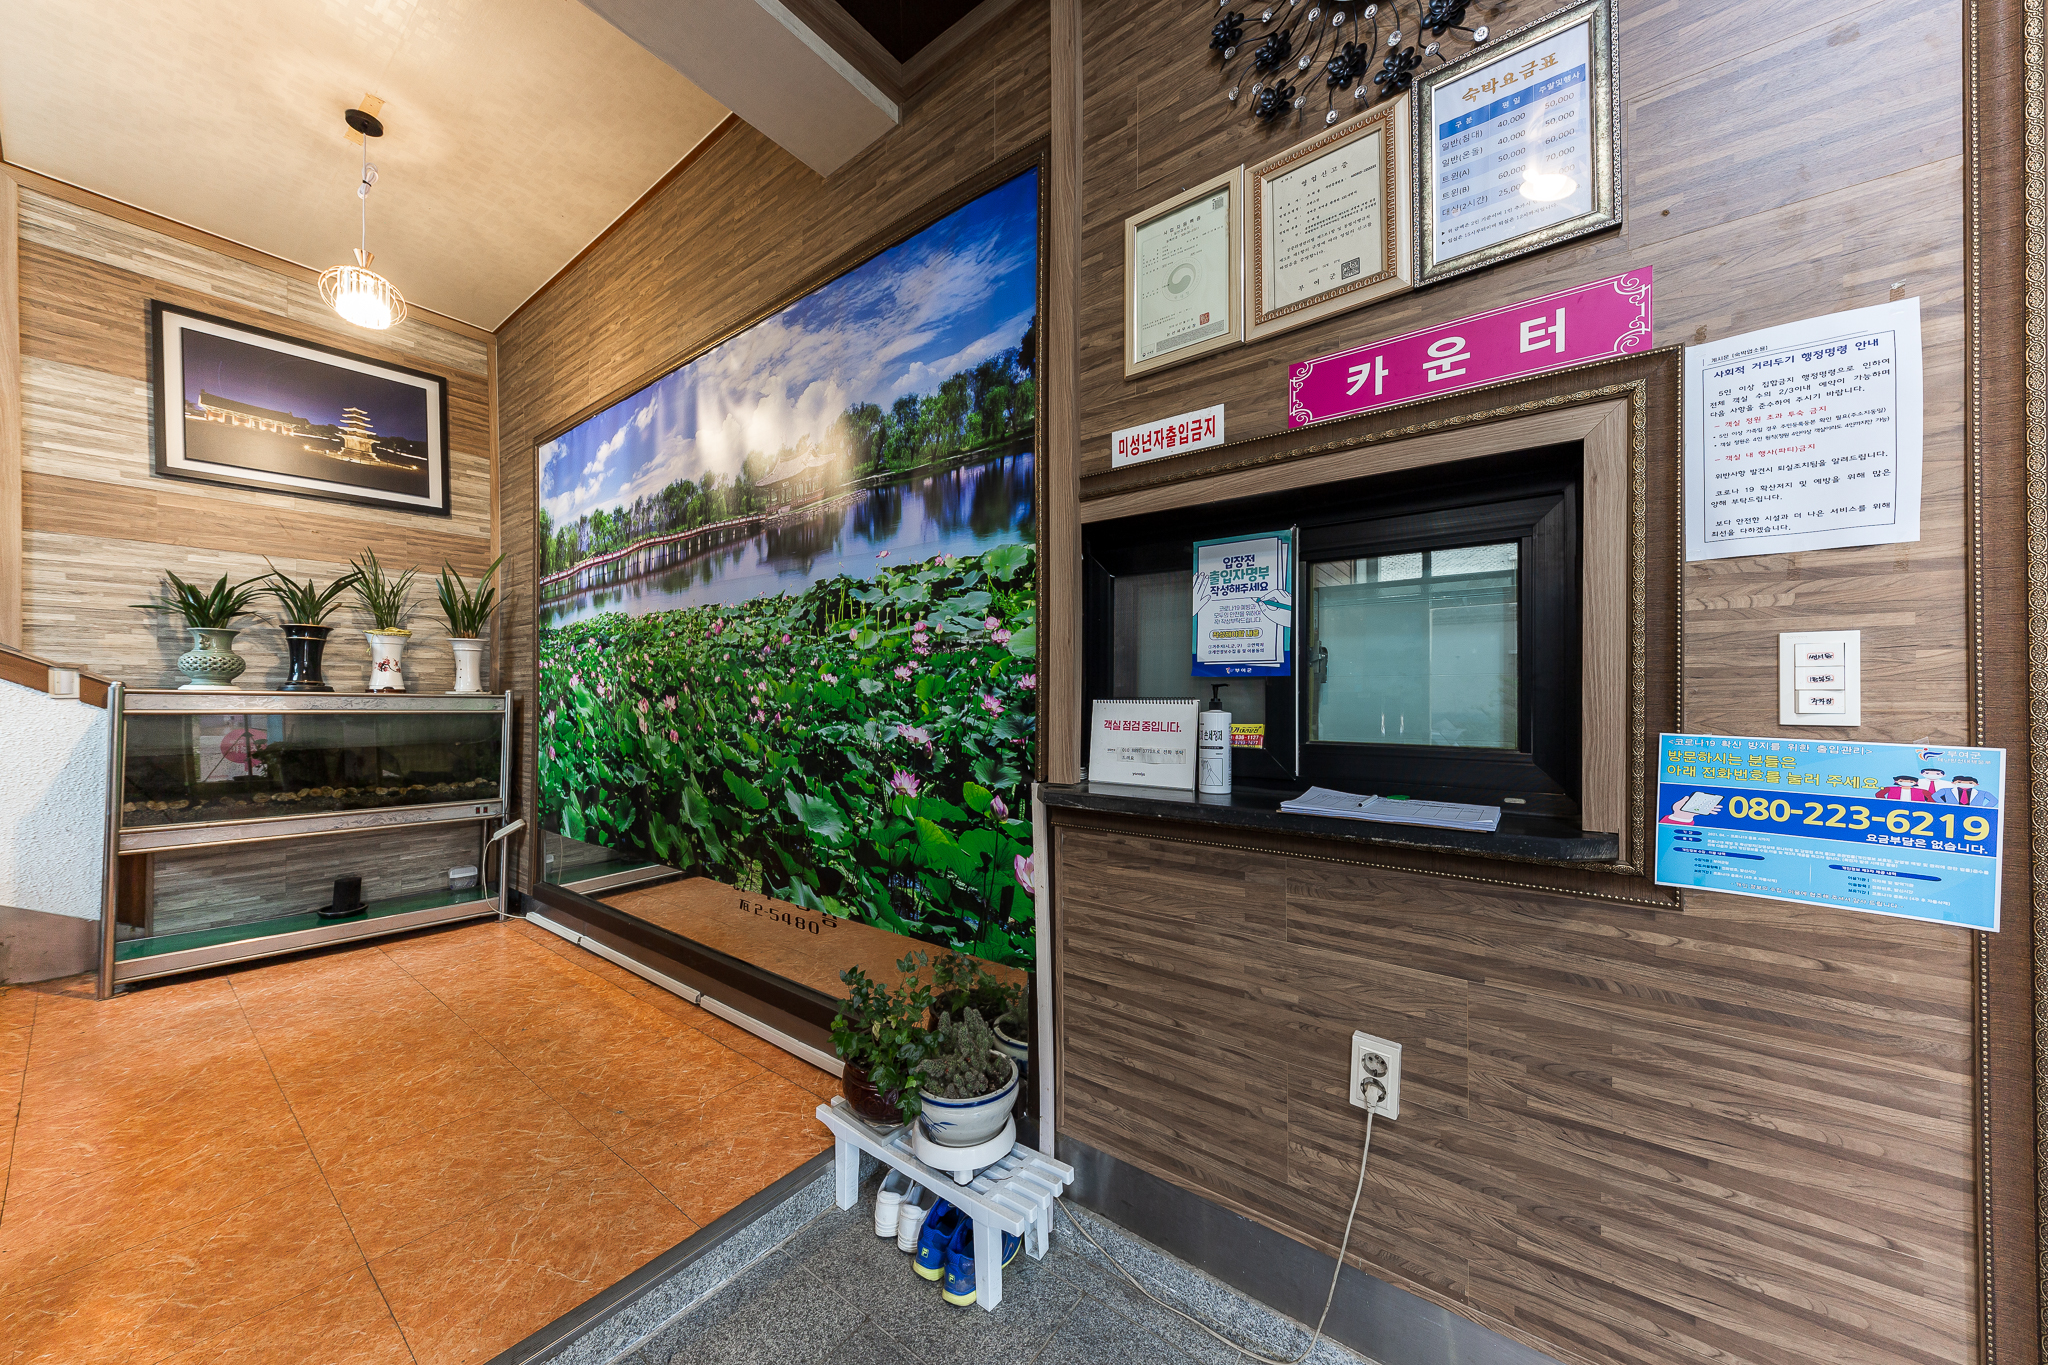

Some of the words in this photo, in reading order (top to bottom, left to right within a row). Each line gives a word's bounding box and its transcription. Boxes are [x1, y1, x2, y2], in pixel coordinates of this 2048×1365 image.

[1462, 52, 1558, 102] 숙박요금표
[1539, 71, 1580, 94] 주말및행사
[1442, 130, 1482, 151] 일반(침대)
[1498, 112, 1525, 127] 40,000
[1545, 93, 1574, 109] 50,000
[1442, 147, 1482, 167] 일반(온돌)
[1498, 130, 1525, 144] 40,000
[1545, 110, 1574, 124] 50,000
[1442, 168, 1470, 183] 트윈(A)
[1498, 148, 1525, 162] 50,000
[1545, 129, 1574, 144] 60,000
[1442, 186, 1469, 200] 트윈(B)
[1498, 165, 1525, 180] 60,000
[1546, 146, 1574, 161] 70,000
[1442, 196, 1488, 216] 대실(2시간)
[1498, 186, 1520, 196] 25,00
[1714, 366, 1744, 378] 사회적
[1752, 355, 1794, 369] 거리두기
[1801, 344, 1847, 362] 행정명령
[1855, 338, 1878, 350] 안내
[1762, 376, 1794, 388] 집합금지
[1802, 366, 1854, 381] 행정명령으로
[1862, 358, 1890, 369] 인하여
[1710, 400, 1725, 409] 전체
[1733, 395, 1748, 403] 객실
[1779, 384, 1810, 395] 2/3이내
[1818, 378, 1844, 387] 예약이
[1854, 369, 1890, 380] 가능하며
[1730, 404, 1754, 413] 사항을
[1758, 398, 1790, 410] 준수하여
[1796, 393, 1820, 402] 주시기
[1826, 386, 1864, 396] 바랍니다.
[1746, 416, 1761, 424] 정원
[1810, 406, 1826, 414] 금지
[1118, 415, 1216, 458] 미성년자출입금지
[1715, 470, 1746, 479] 위반사항
[1750, 467, 1772, 476] 발견시
[1831, 451, 1888, 465] 알려드립니다.
[1726, 454, 1740, 462] 객실
[1758, 444, 1815, 457] 행사(파티)금지
[1715, 488, 1739, 496] 코로나
[1760, 482, 1792, 492] 확산저지
[1814, 476, 1840, 484] 예방을
[1847, 472, 1865, 480] 위해
[1872, 469, 1891, 478] 많은
[1710, 500, 1726, 508] 양해
[1732, 494, 1782, 504] 부탁드립니다.
[1736, 517, 1760, 525] 안전한
[1765, 514, 1788, 522] 시설과
[1830, 505, 1866, 514] 서비스를
[1712, 529, 1735, 537] 최선을
[1740, 525, 1790, 534] 다하겠습니다.
[1223, 554, 1255, 569] 입장전
[1209, 566, 1269, 585] 출입자명부
[1210, 582, 1268, 597] 작성해주세요
[1104, 719, 1122, 730] 객실
[1122, 720, 1140, 732] 점검
[1141, 720, 1182, 733] 중입니다.
[1668, 739, 1716, 747] <코로나19
[1721, 740, 1742, 749] 확산
[1748, 742, 1780, 751] 방지를
[1788, 743, 1810, 752] 위한
[1816, 744, 1874, 755] 출입관리>
[1668, 750, 1742, 766] 방문하시는
[1748, 755, 1796, 769] 분들은
[1947, 751, 1981, 759] 부여군
[1668, 765, 1696, 777] 아래
[1703, 767, 1780, 783] 전화번호를
[1787, 772, 1819, 786] 눌러
[1826, 774, 1885, 790] 주세요.
[1728, 796, 1990, 841] 080-223-6219
[1866, 834, 1927, 848] 요금부담은
[1931, 840, 1988, 854] 없습니다.
[754, 903, 820, 935] 2-5480
